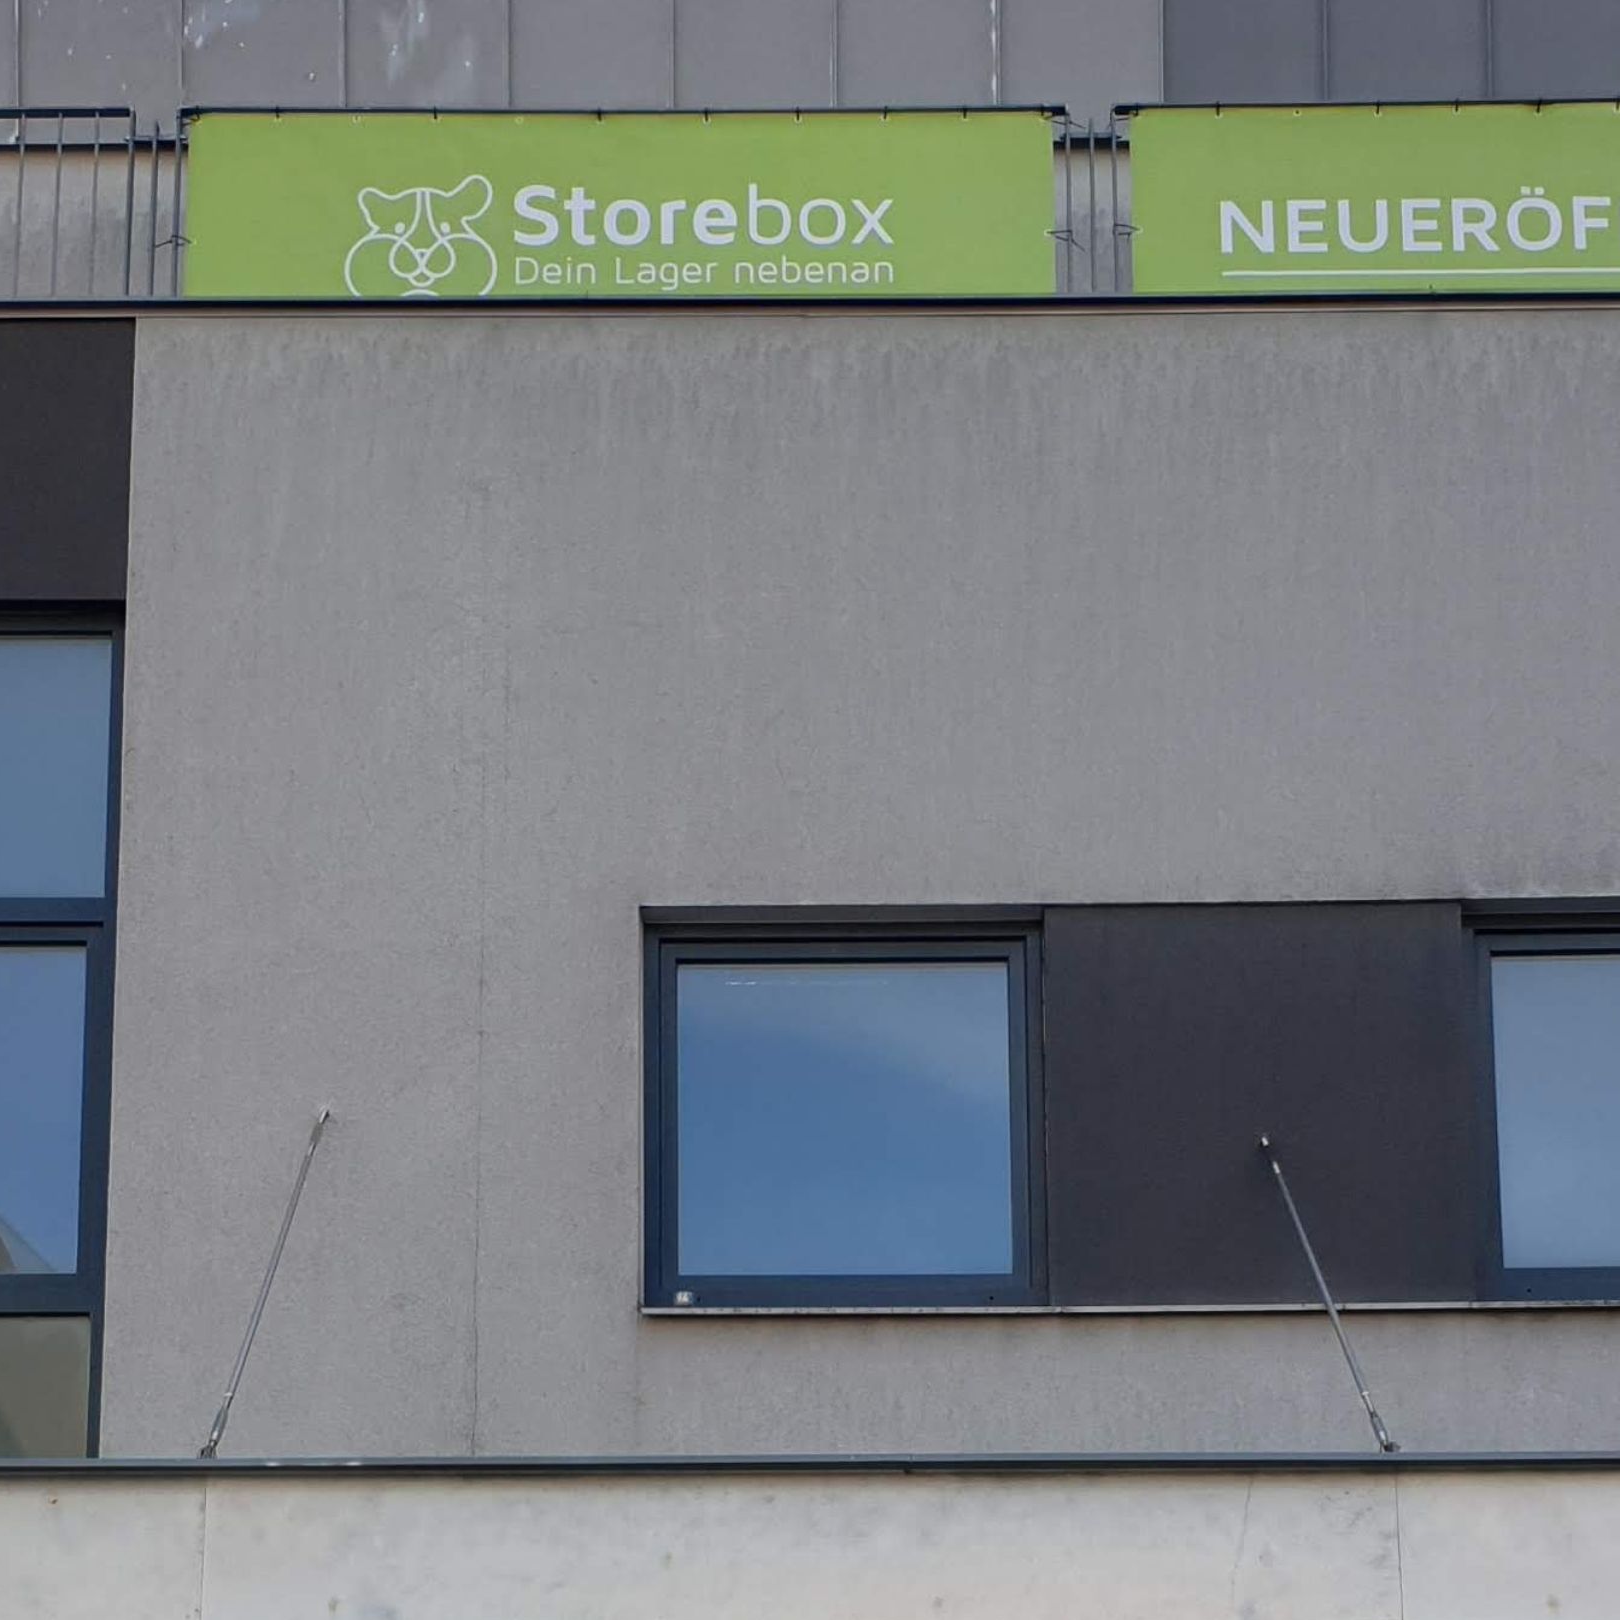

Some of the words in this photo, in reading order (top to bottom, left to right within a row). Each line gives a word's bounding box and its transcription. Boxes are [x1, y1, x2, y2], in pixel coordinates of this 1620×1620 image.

[513, 183, 894, 247] Storebox
[515, 256, 596, 285] Dein
[615, 257, 718, 291] Lager
[734, 255, 894, 284] nebenan
